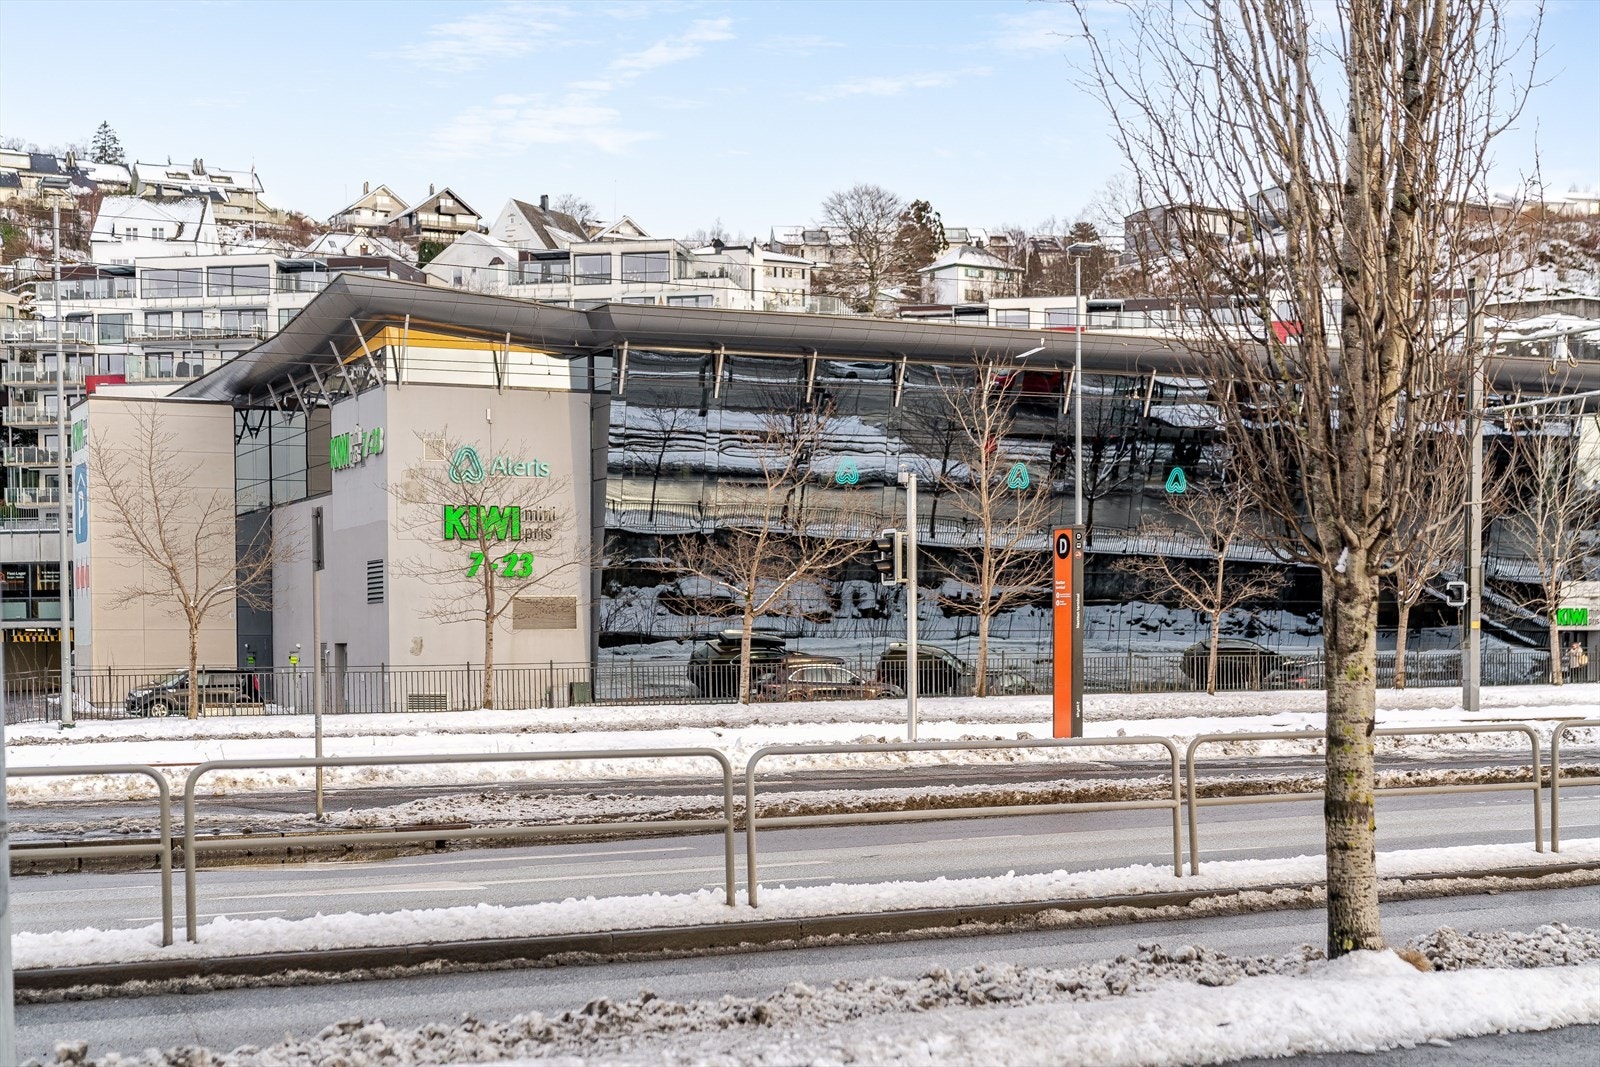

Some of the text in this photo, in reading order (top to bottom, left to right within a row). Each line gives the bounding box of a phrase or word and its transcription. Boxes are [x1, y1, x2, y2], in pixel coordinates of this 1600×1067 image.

[330, 432, 350, 471] KIWI
[490, 456, 550, 477] Aleris
[444, 504, 521, 541] KIWI
[524, 506, 556, 521] mini
[524, 525, 552, 542] pris
[1059, 538, 1068, 555] D
[1556, 608, 1588, 626] KIWI
